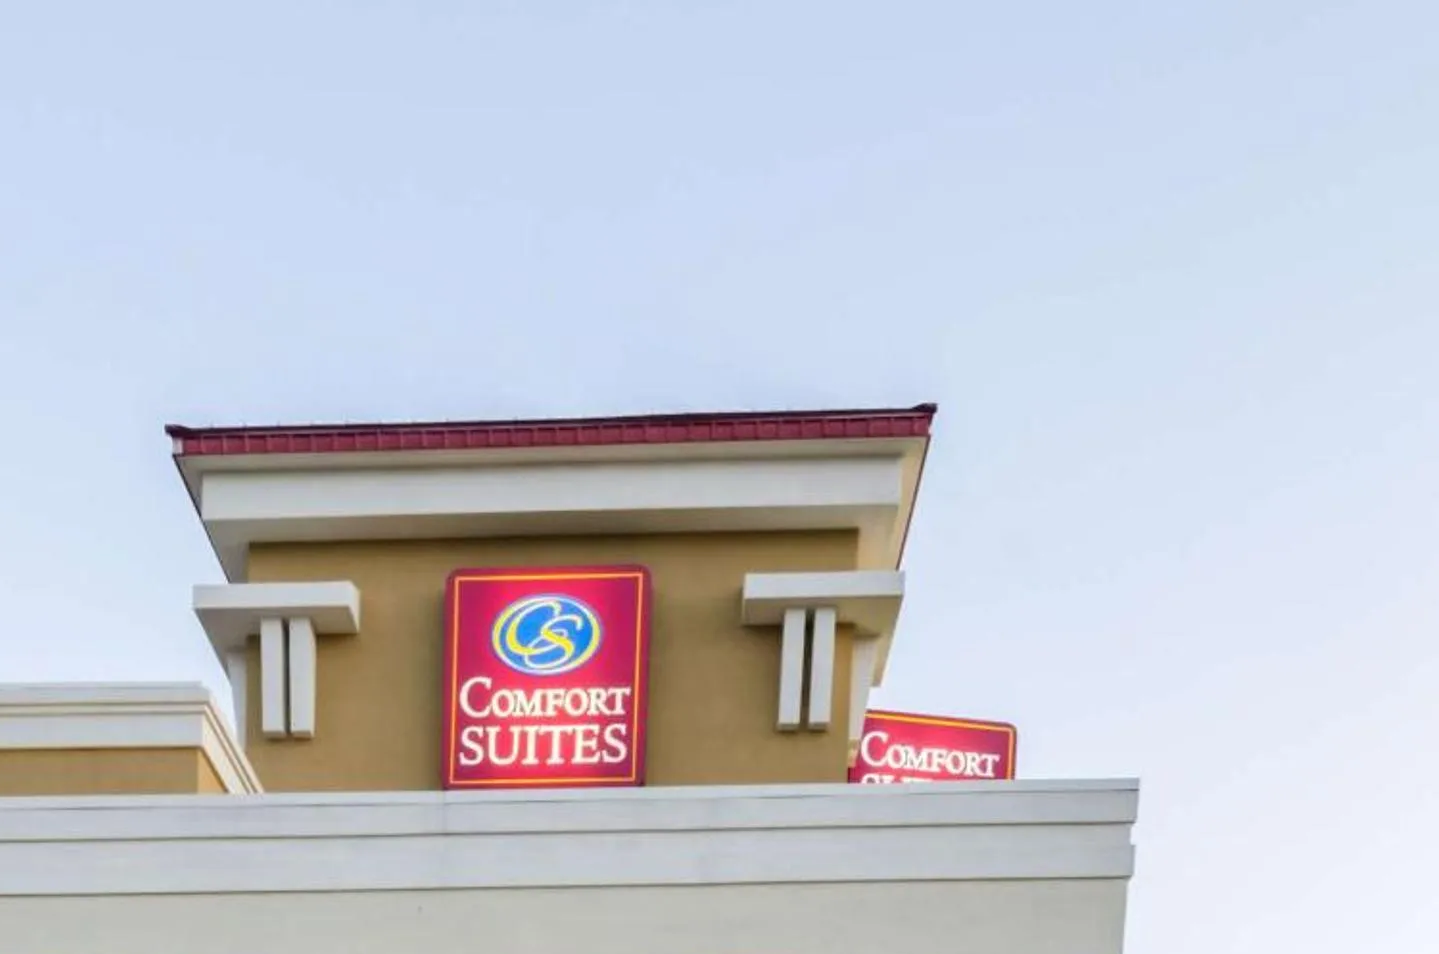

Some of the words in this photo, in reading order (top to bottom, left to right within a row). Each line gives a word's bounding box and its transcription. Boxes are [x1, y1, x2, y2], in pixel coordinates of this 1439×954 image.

[459, 676, 631, 718] COMFORT
[459, 724, 628, 766] SUITES
[861, 731, 1000, 777] COMFORT
